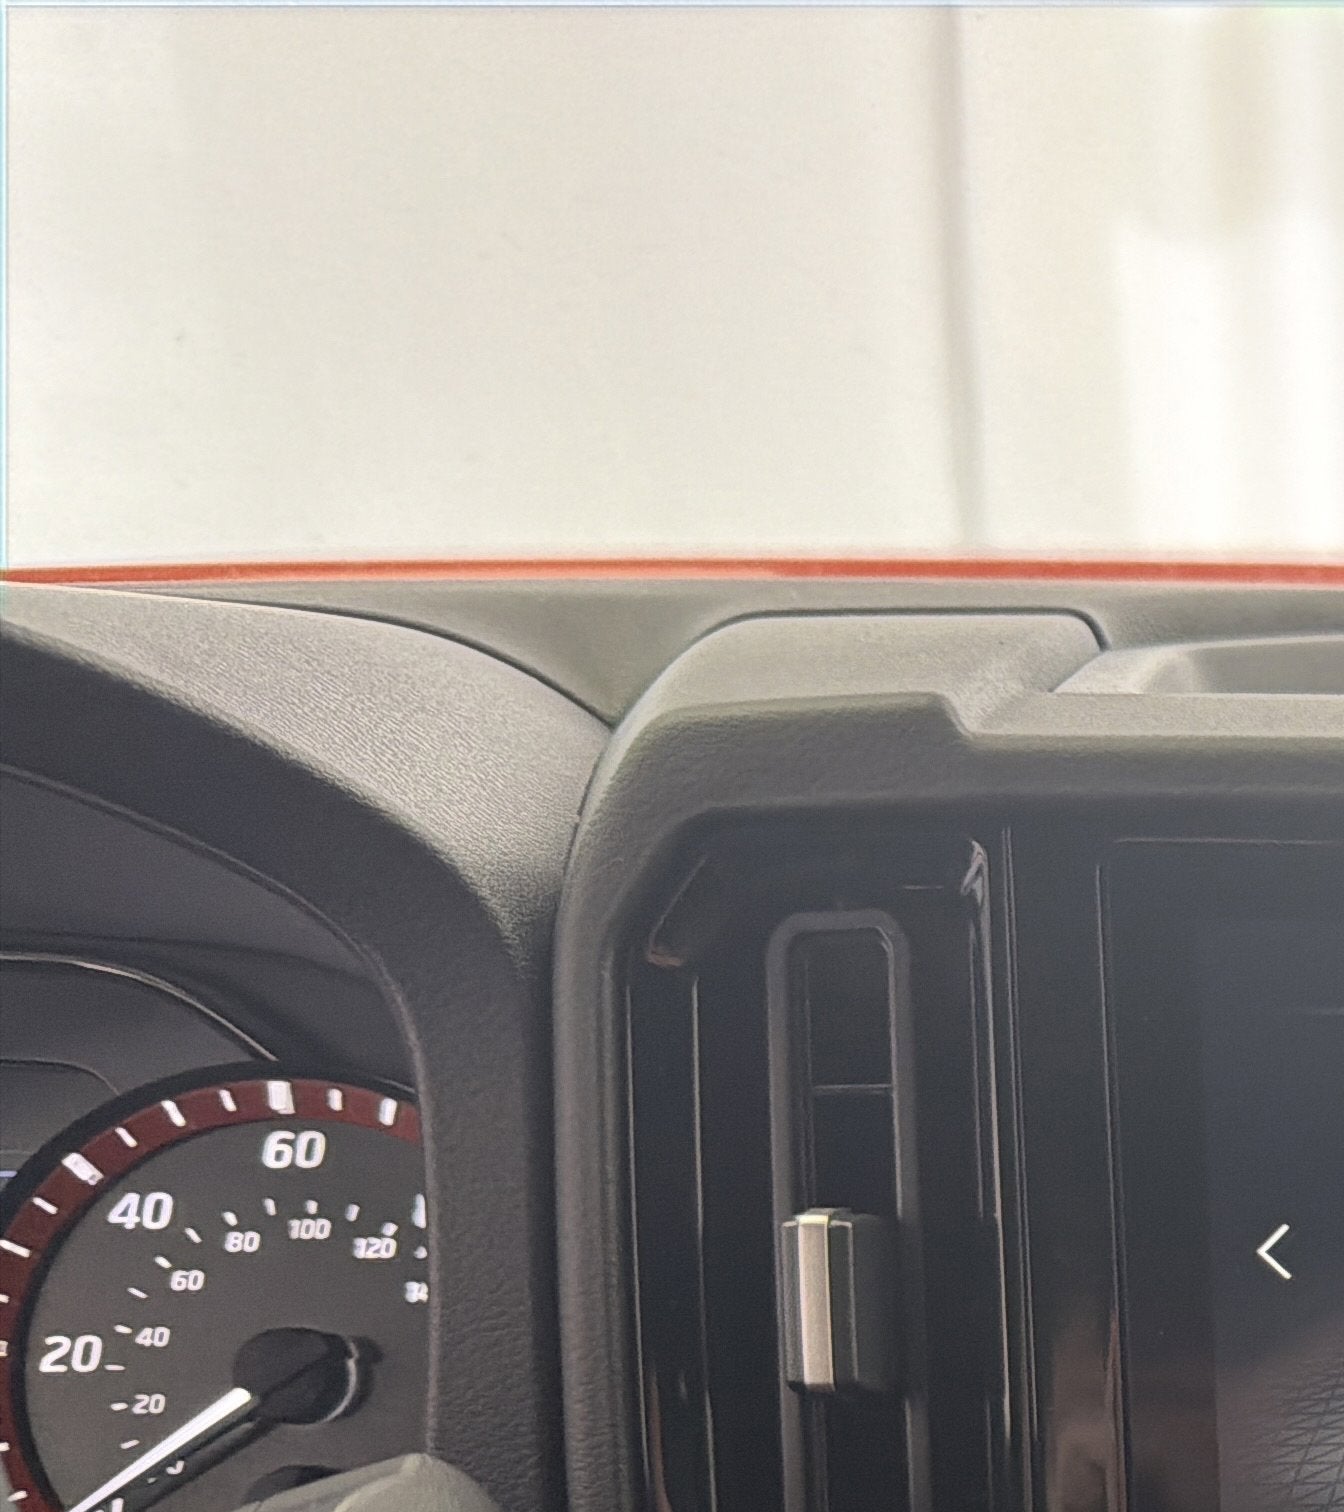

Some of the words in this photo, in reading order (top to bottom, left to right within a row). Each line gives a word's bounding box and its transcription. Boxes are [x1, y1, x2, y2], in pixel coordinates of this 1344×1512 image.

[262, 1131, 326, 1168] 60
[107, 1192, 174, 1229] 40
[288, 1217, 331, 1241] 100
[224, 1231, 260, 1254] 80
[353, 1236, 397, 1260] 120
[170, 1269, 205, 1291] 60
[135, 1326, 170, 1348] 40
[39, 1335, 102, 1373] 20
[132, 1394, 166, 1415] 20
